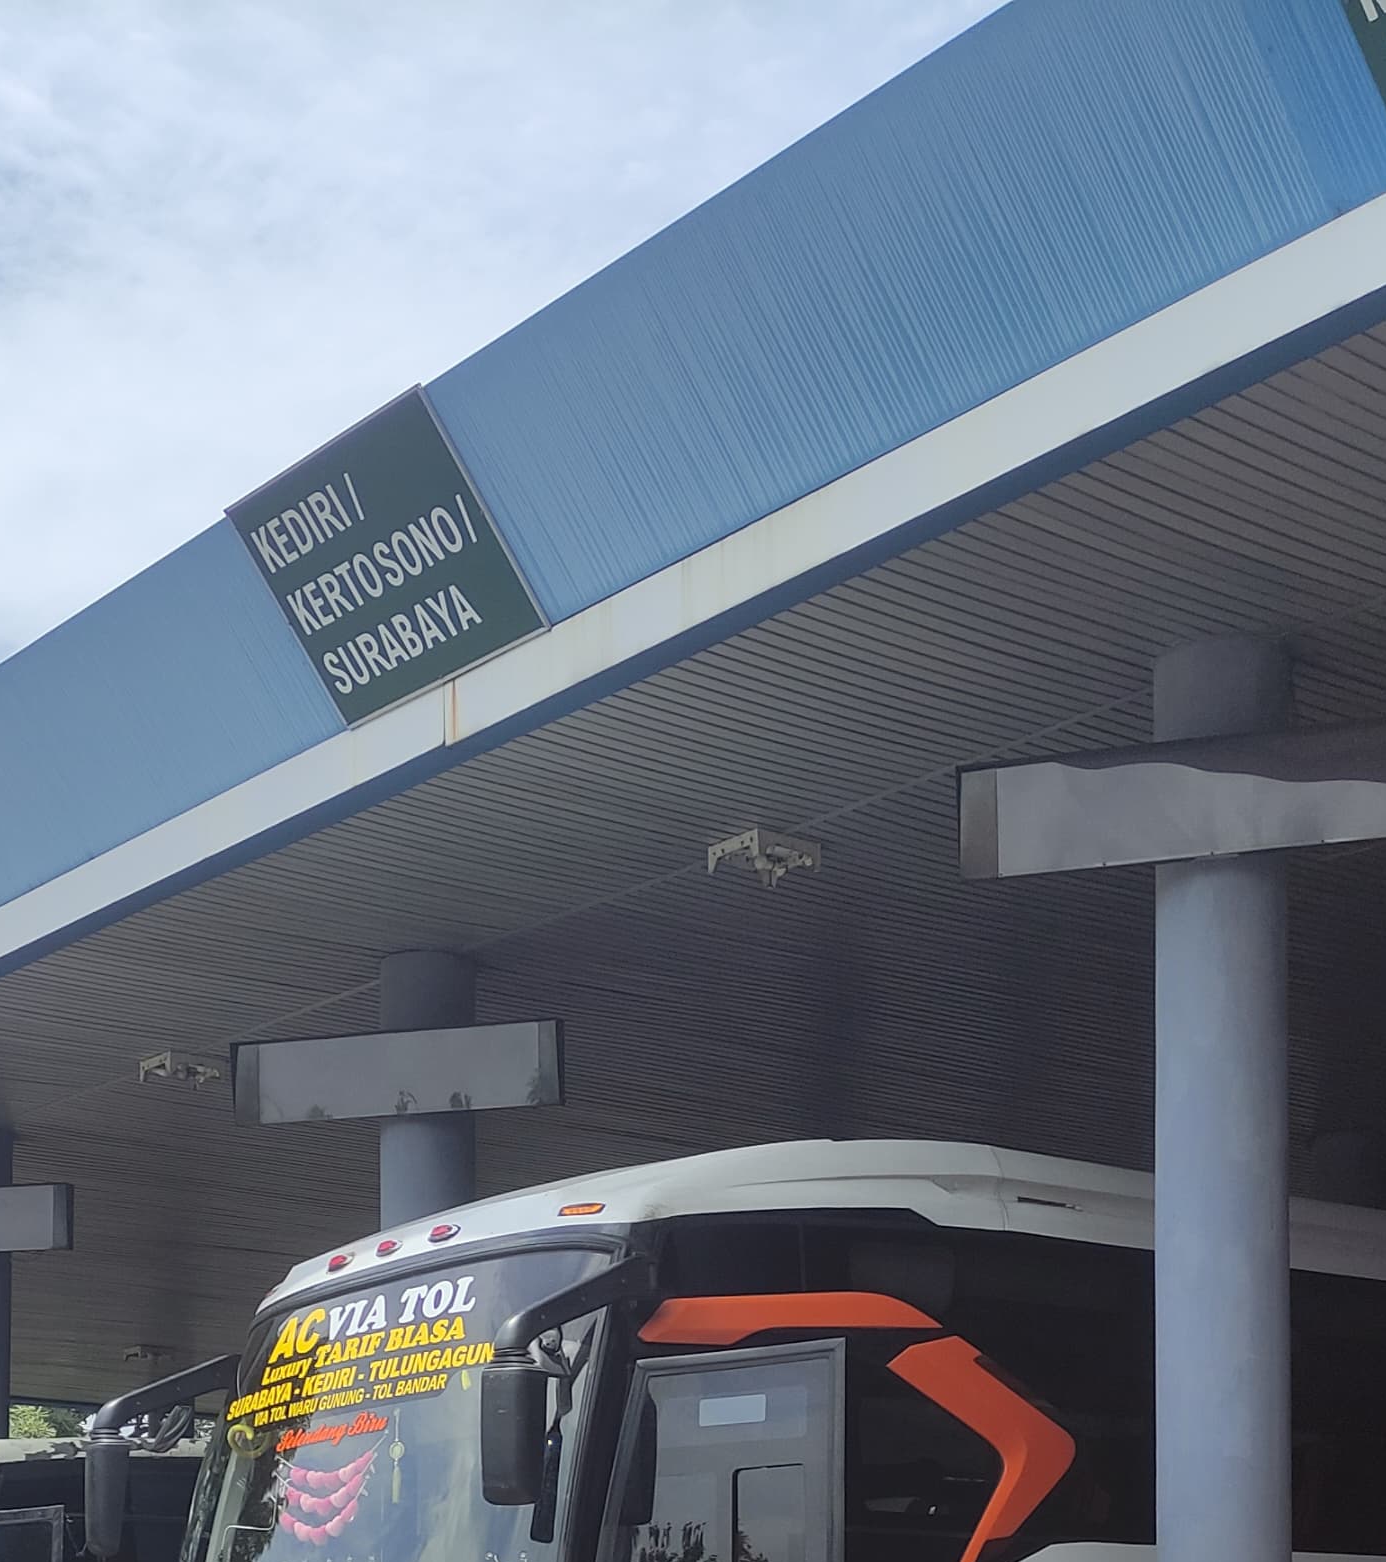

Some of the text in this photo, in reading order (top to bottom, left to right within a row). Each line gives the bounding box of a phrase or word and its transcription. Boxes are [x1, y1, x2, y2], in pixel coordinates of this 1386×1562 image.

[322, 584, 483, 696] SURABAYA
[261, 1315, 465, 1387] Luxury TARIF BIASA
[268, 1275, 477, 1364] AC VIA TOL
[226, 1379, 292, 1422] SURABAYA
[301, 1366, 357, 1398] KEDIRI
[369, 1341, 495, 1382] TULUNGAGUN
[269, 1406, 288, 1424] TOL
[287, 1399, 319, 1420] WARU
[319, 1387, 365, 1413] GUNUNG
[372, 1382, 396, 1402] TOL
[396, 1372, 448, 1398] BANDAR
